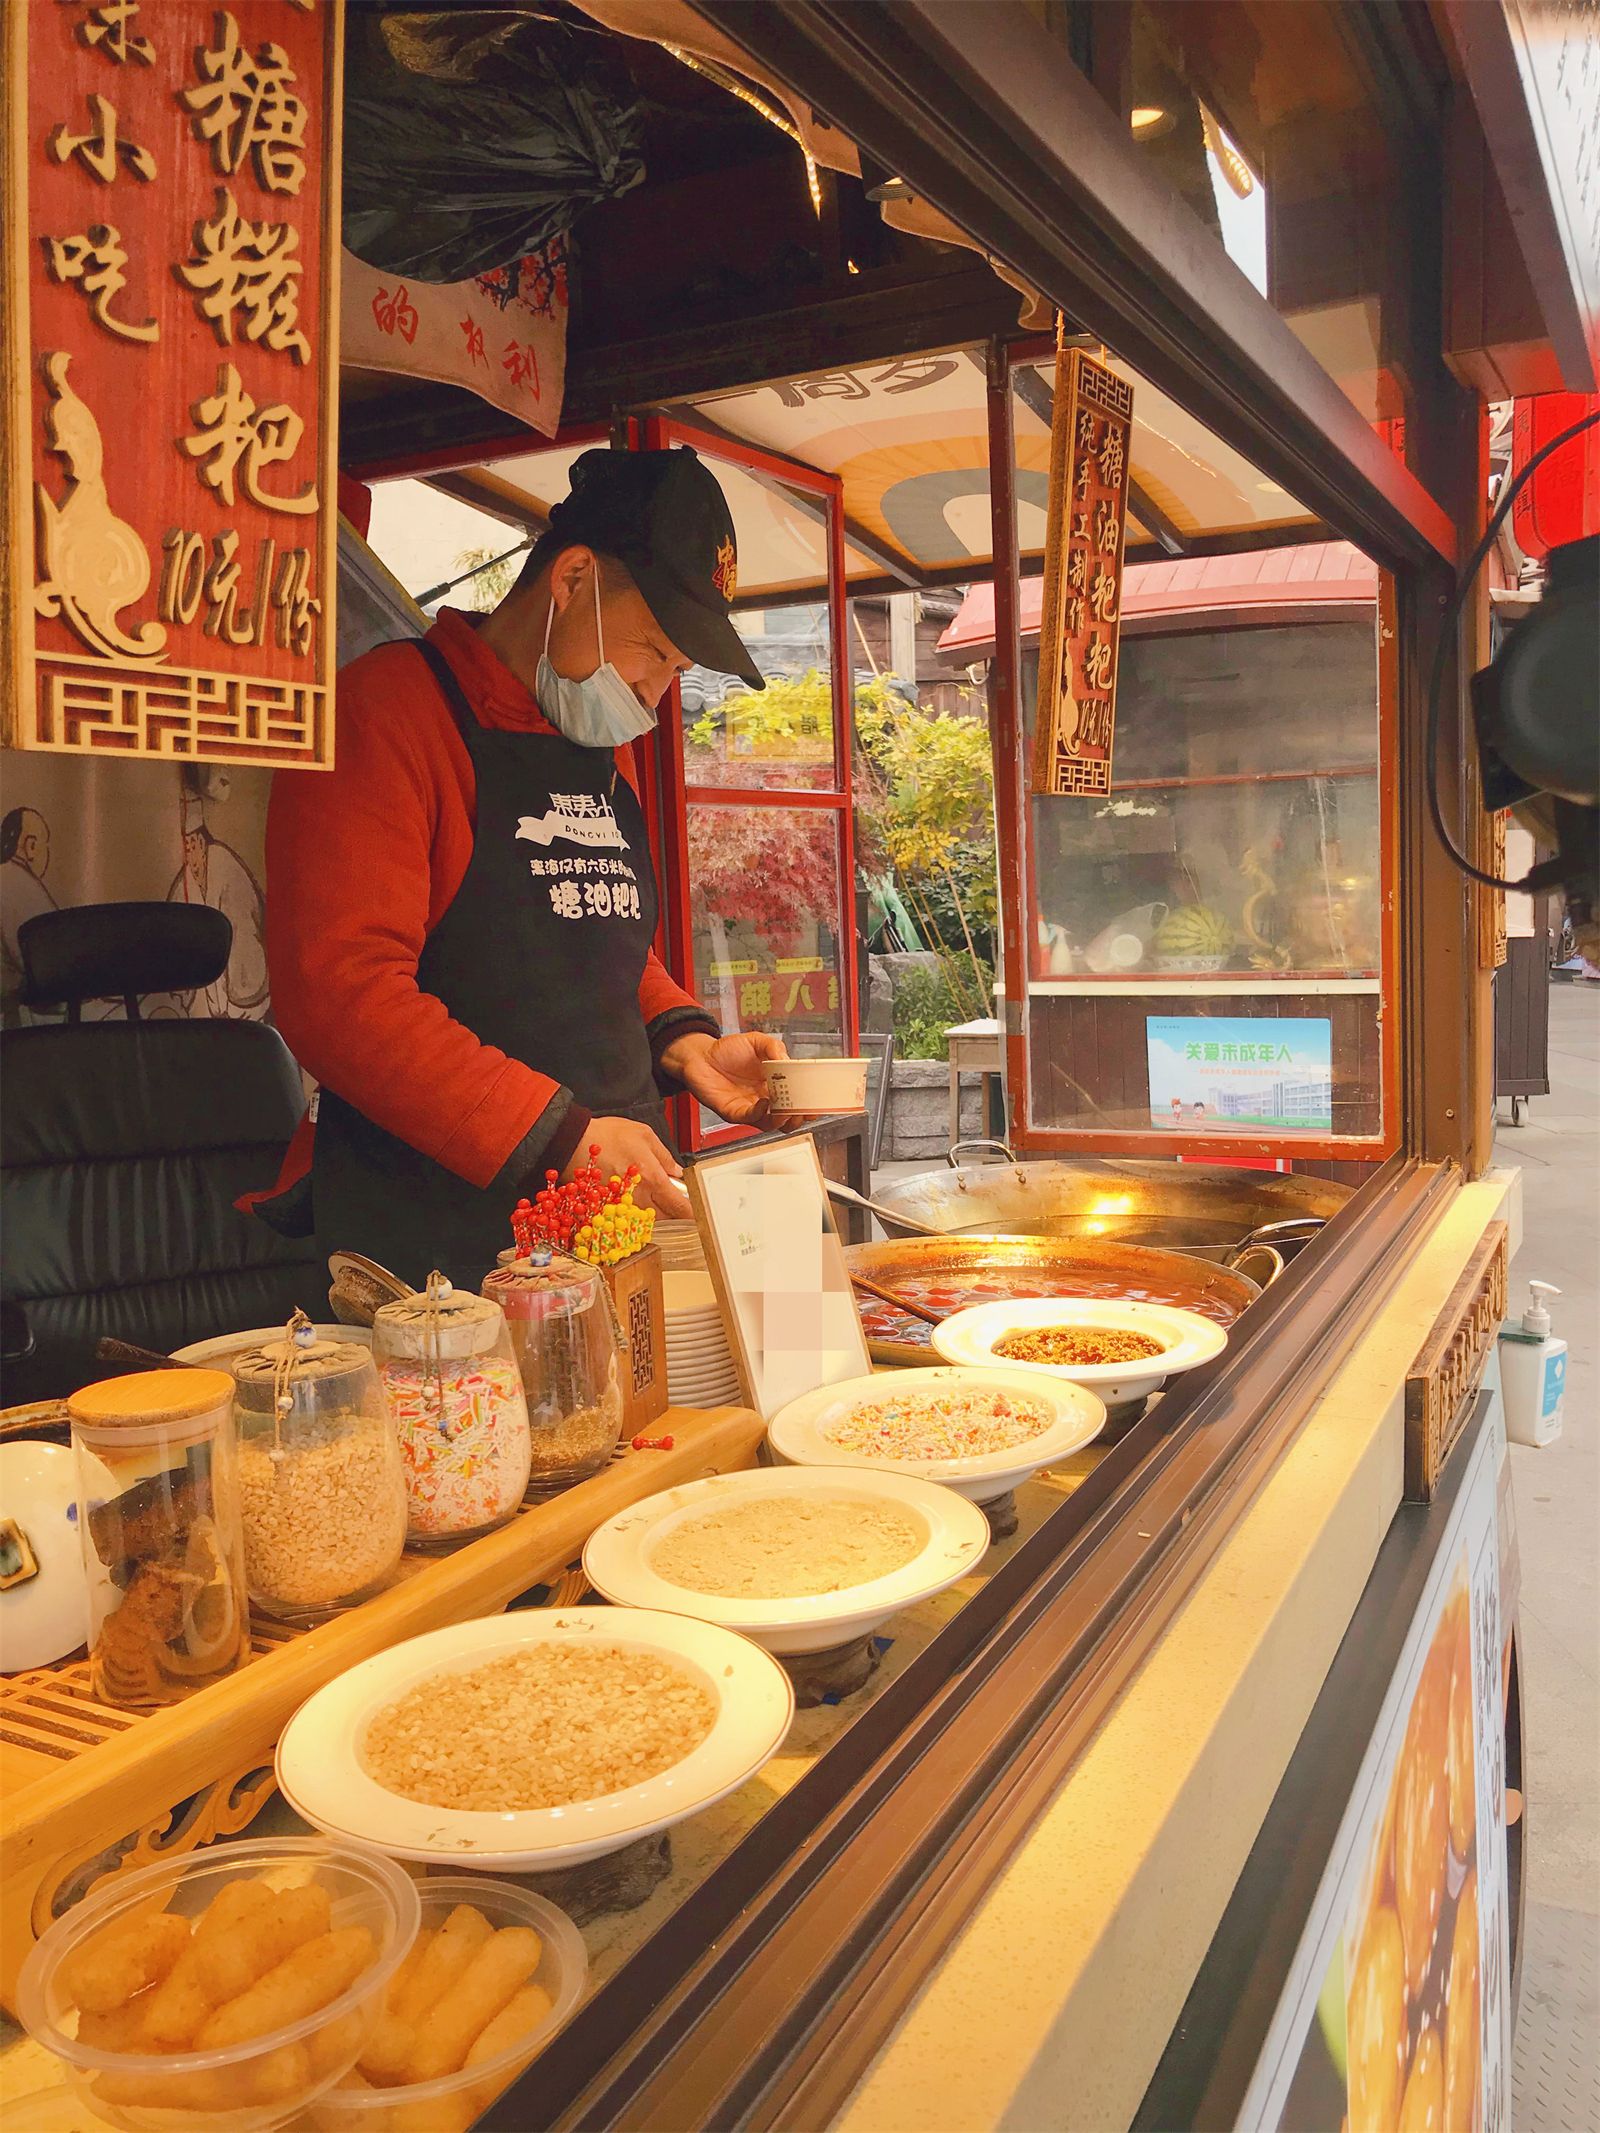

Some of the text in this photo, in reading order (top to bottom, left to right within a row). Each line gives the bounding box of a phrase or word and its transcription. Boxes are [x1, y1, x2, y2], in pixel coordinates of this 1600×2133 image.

[178, 0, 319, 515] 糖糍粑
[164, 527, 322, 658] 10元/份
[1069, 410, 1098, 634] 纯手工制作
[1086, 422, 1125, 690] 糖油粑粑
[1185, 1041, 1293, 1063] 关爱未成年人
